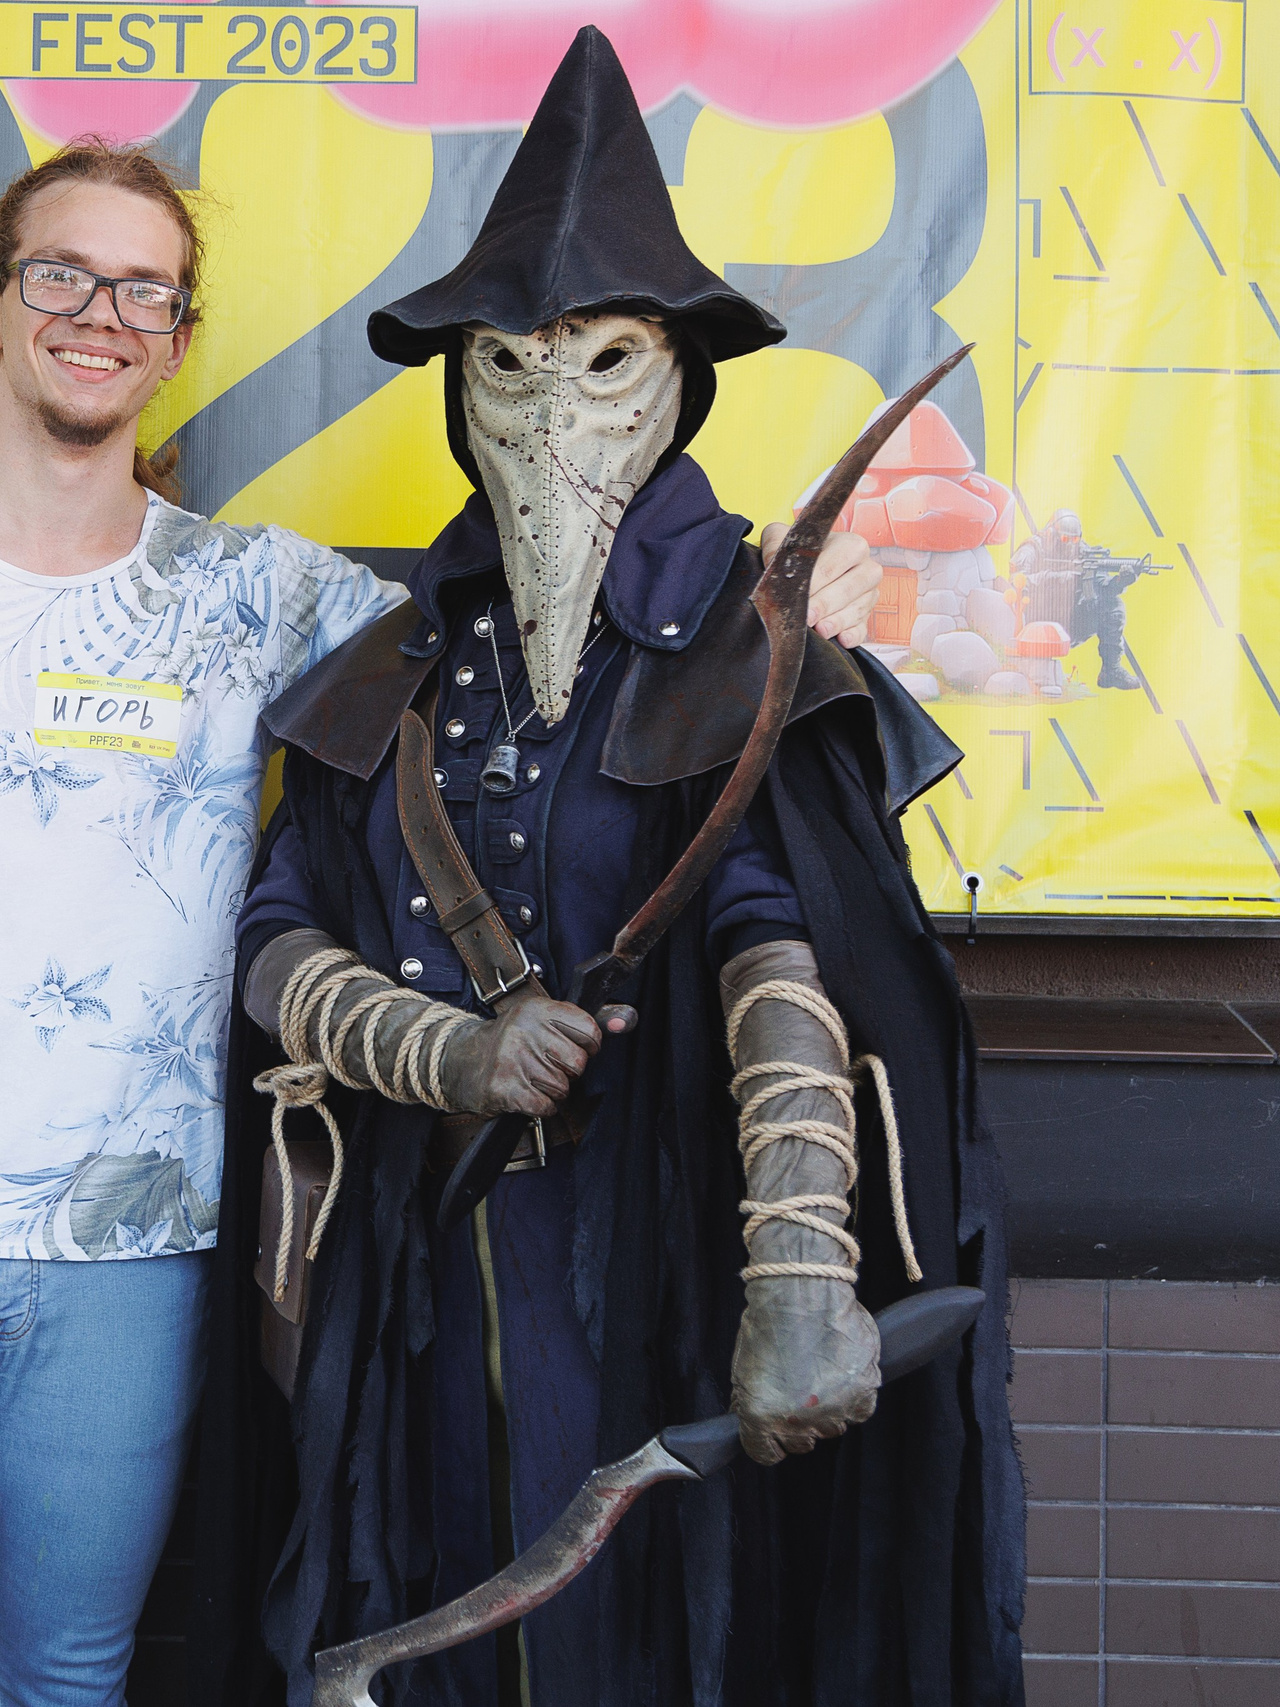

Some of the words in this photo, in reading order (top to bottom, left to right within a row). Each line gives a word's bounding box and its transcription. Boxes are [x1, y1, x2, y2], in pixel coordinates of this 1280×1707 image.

[32, 11, 204, 74] FEST
[227, 16, 397, 77] 2023
[76, 677, 103, 687] Привет,
[53, 696, 154, 730] ИГОРЬ
[89, 735, 123, 747] PPF23
